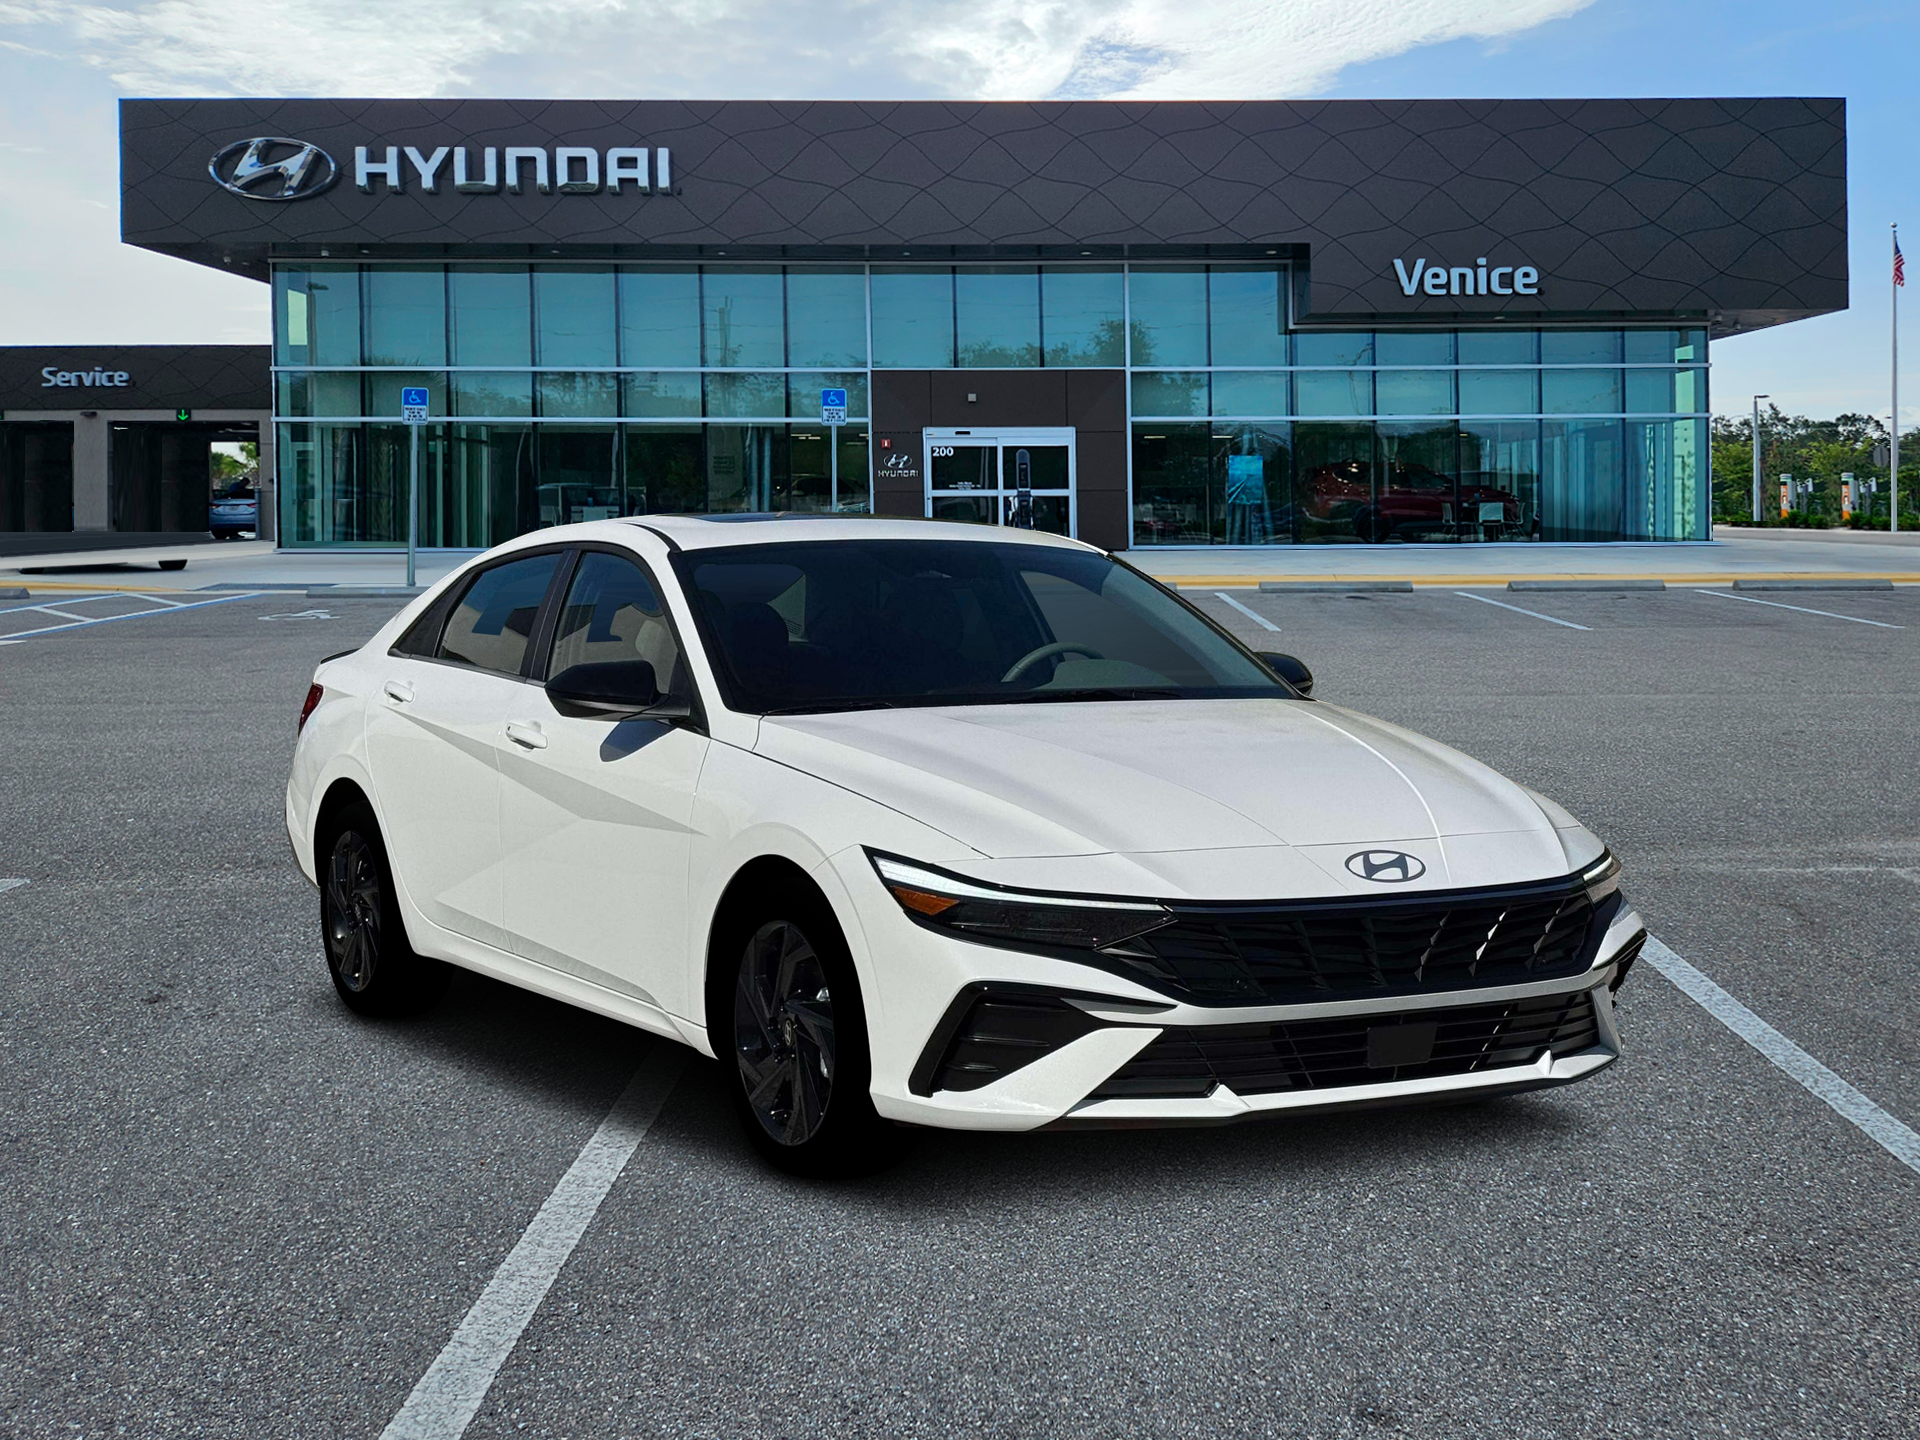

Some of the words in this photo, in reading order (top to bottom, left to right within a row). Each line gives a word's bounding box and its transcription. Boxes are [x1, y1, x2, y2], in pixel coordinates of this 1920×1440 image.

[354, 145, 671, 194] HYUNDAI
[1392, 256, 1540, 297] Venice
[41, 366, 130, 388] Service
[932, 447, 954, 457] 200
[877, 470, 919, 478] HYUNDAI
